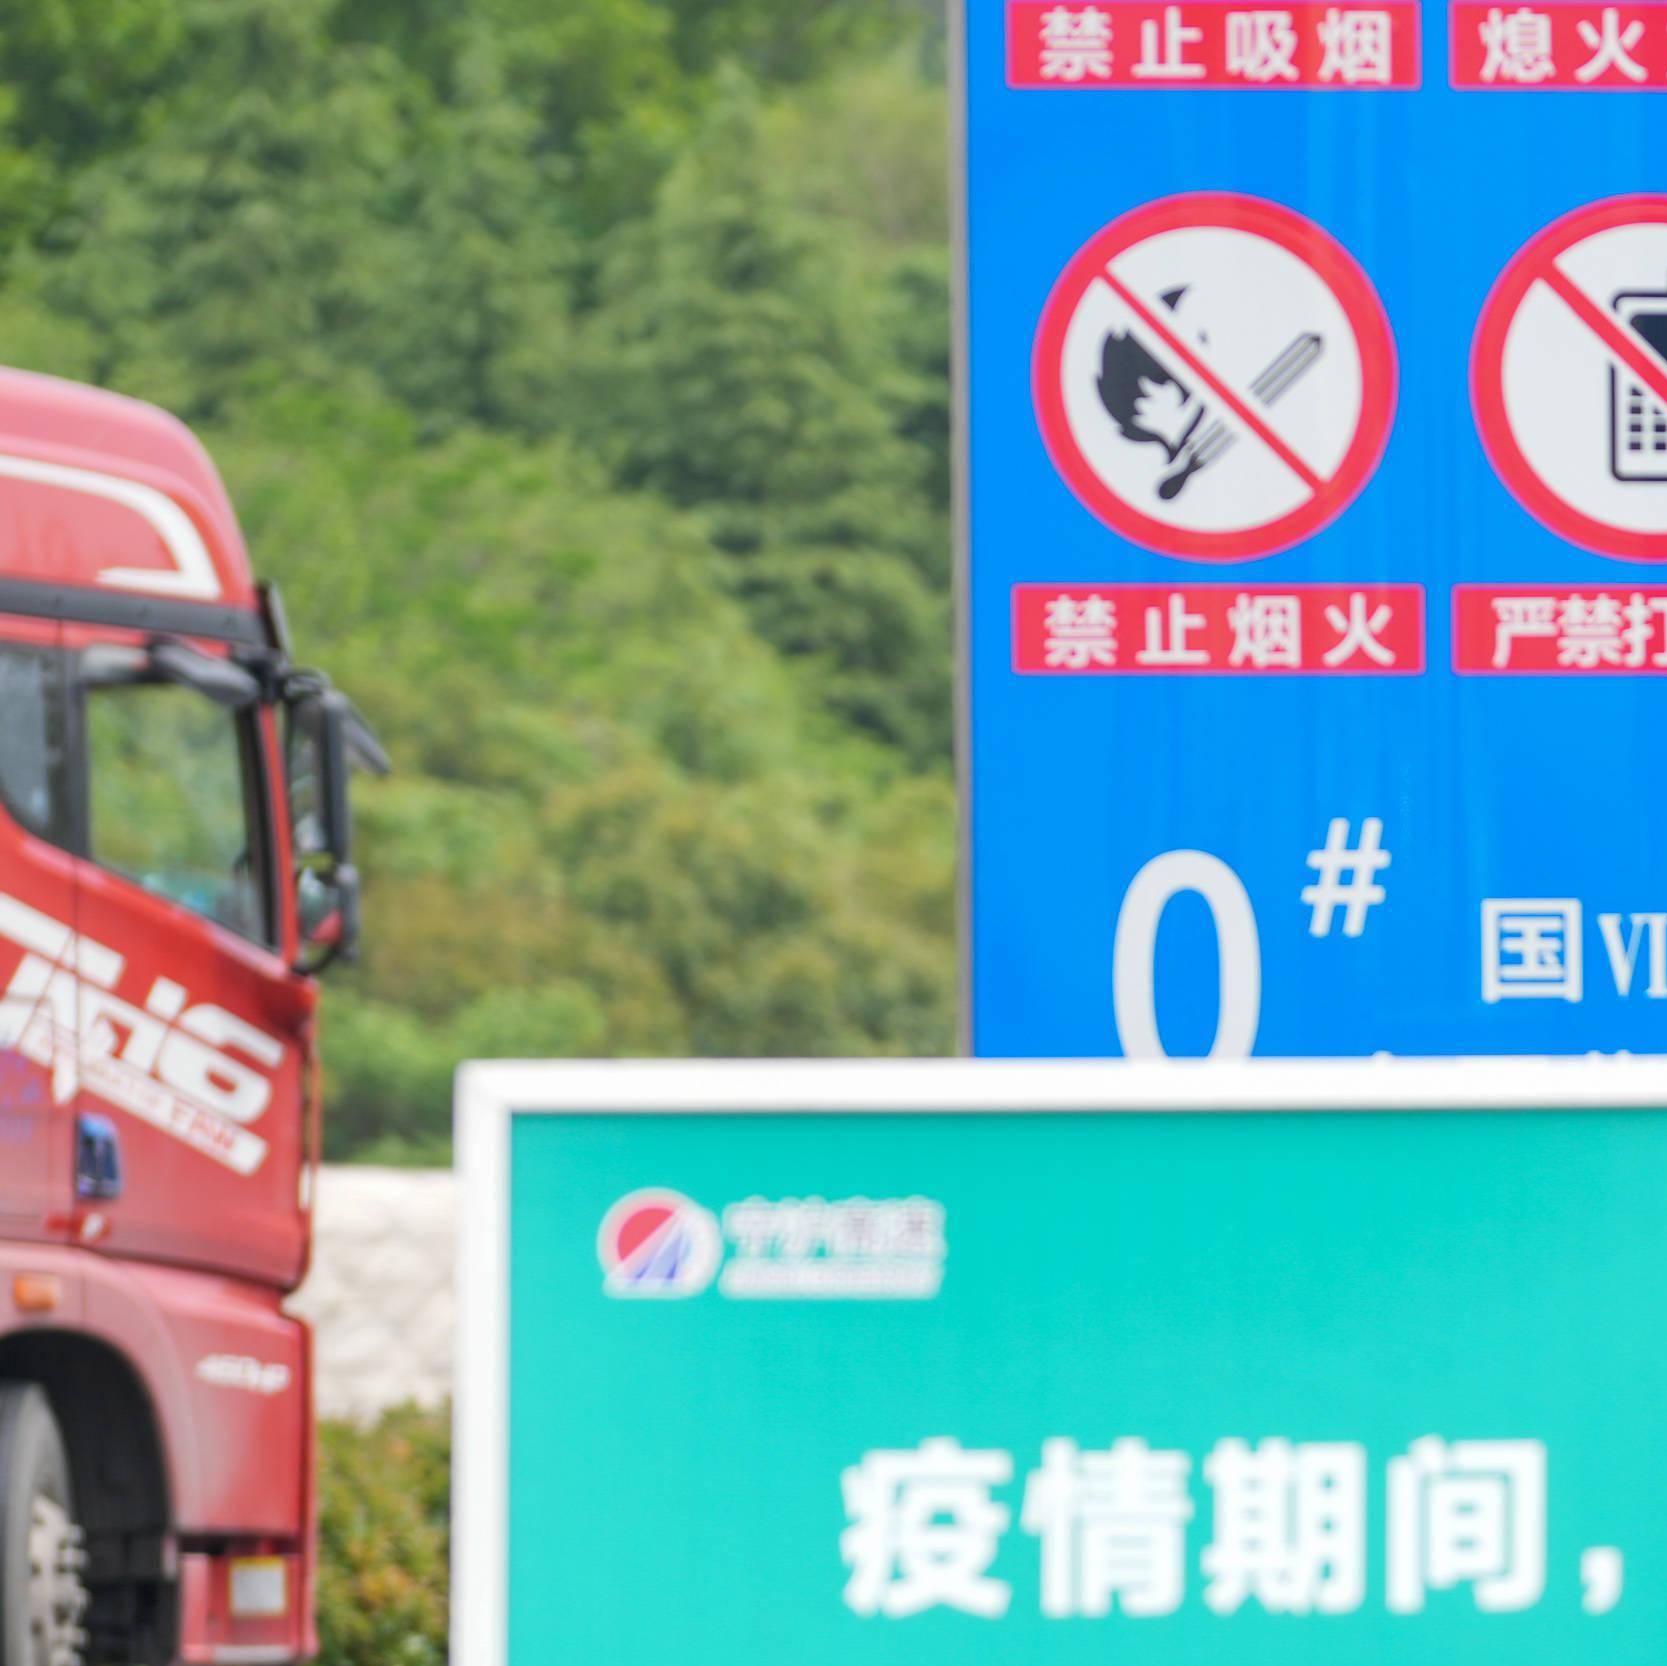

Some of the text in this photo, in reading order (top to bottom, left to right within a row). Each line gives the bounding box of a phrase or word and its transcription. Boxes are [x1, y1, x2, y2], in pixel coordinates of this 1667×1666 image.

[1039, 6, 1394, 84] 禁止吸烟
[1043, 593, 1396, 670] 禁止烟火
[840, 1436, 1625, 1619] 疫情期间，
